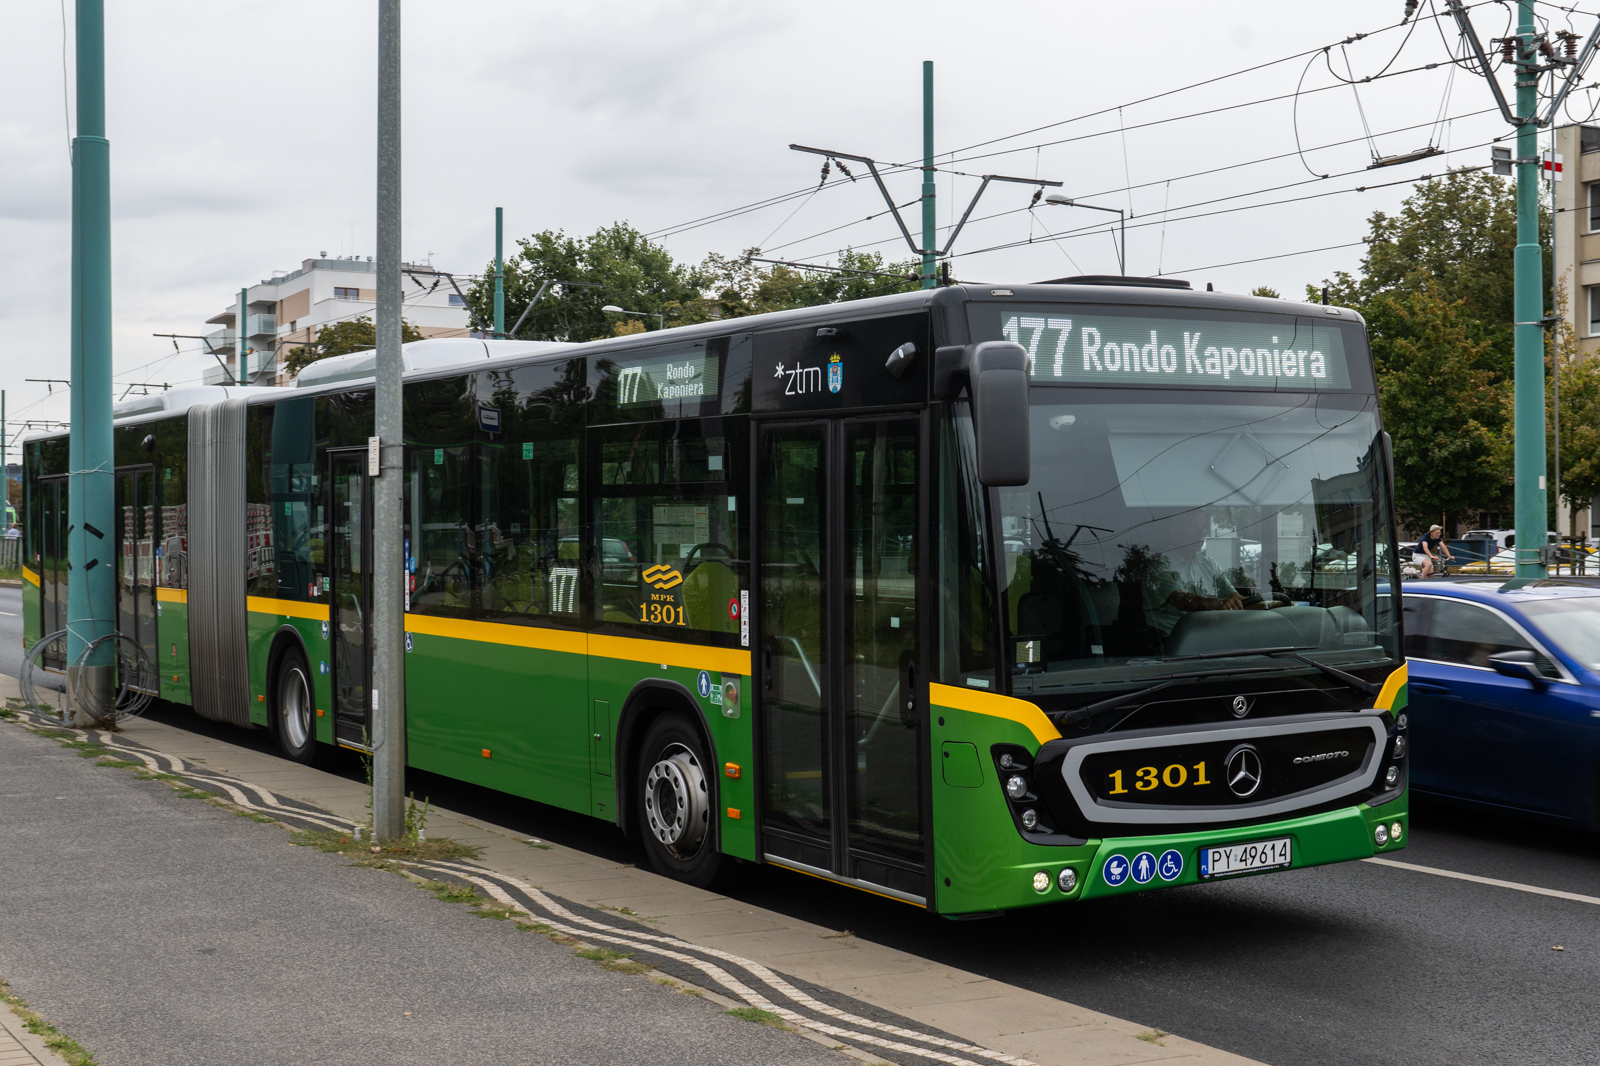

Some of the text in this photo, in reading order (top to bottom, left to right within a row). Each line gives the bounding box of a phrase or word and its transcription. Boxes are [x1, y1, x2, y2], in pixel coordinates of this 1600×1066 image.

[1081, 327, 1177, 373] Rondo
[1183, 331, 1326, 379] Kaponiera
[666, 361, 695, 380] Rondo
[617, 366, 642, 404] 177
[657, 380, 704, 399] Kaponiera
[549, 567, 578, 613] 177
[650, 593, 675, 602] MPK
[640, 602, 687, 626] 1301
[1292, 750, 1350, 765] CONECTO
[1108, 761, 1211, 795] 1301
[1212, 848, 1233, 872] PY
[1239, 841, 1287, 867] 49614
